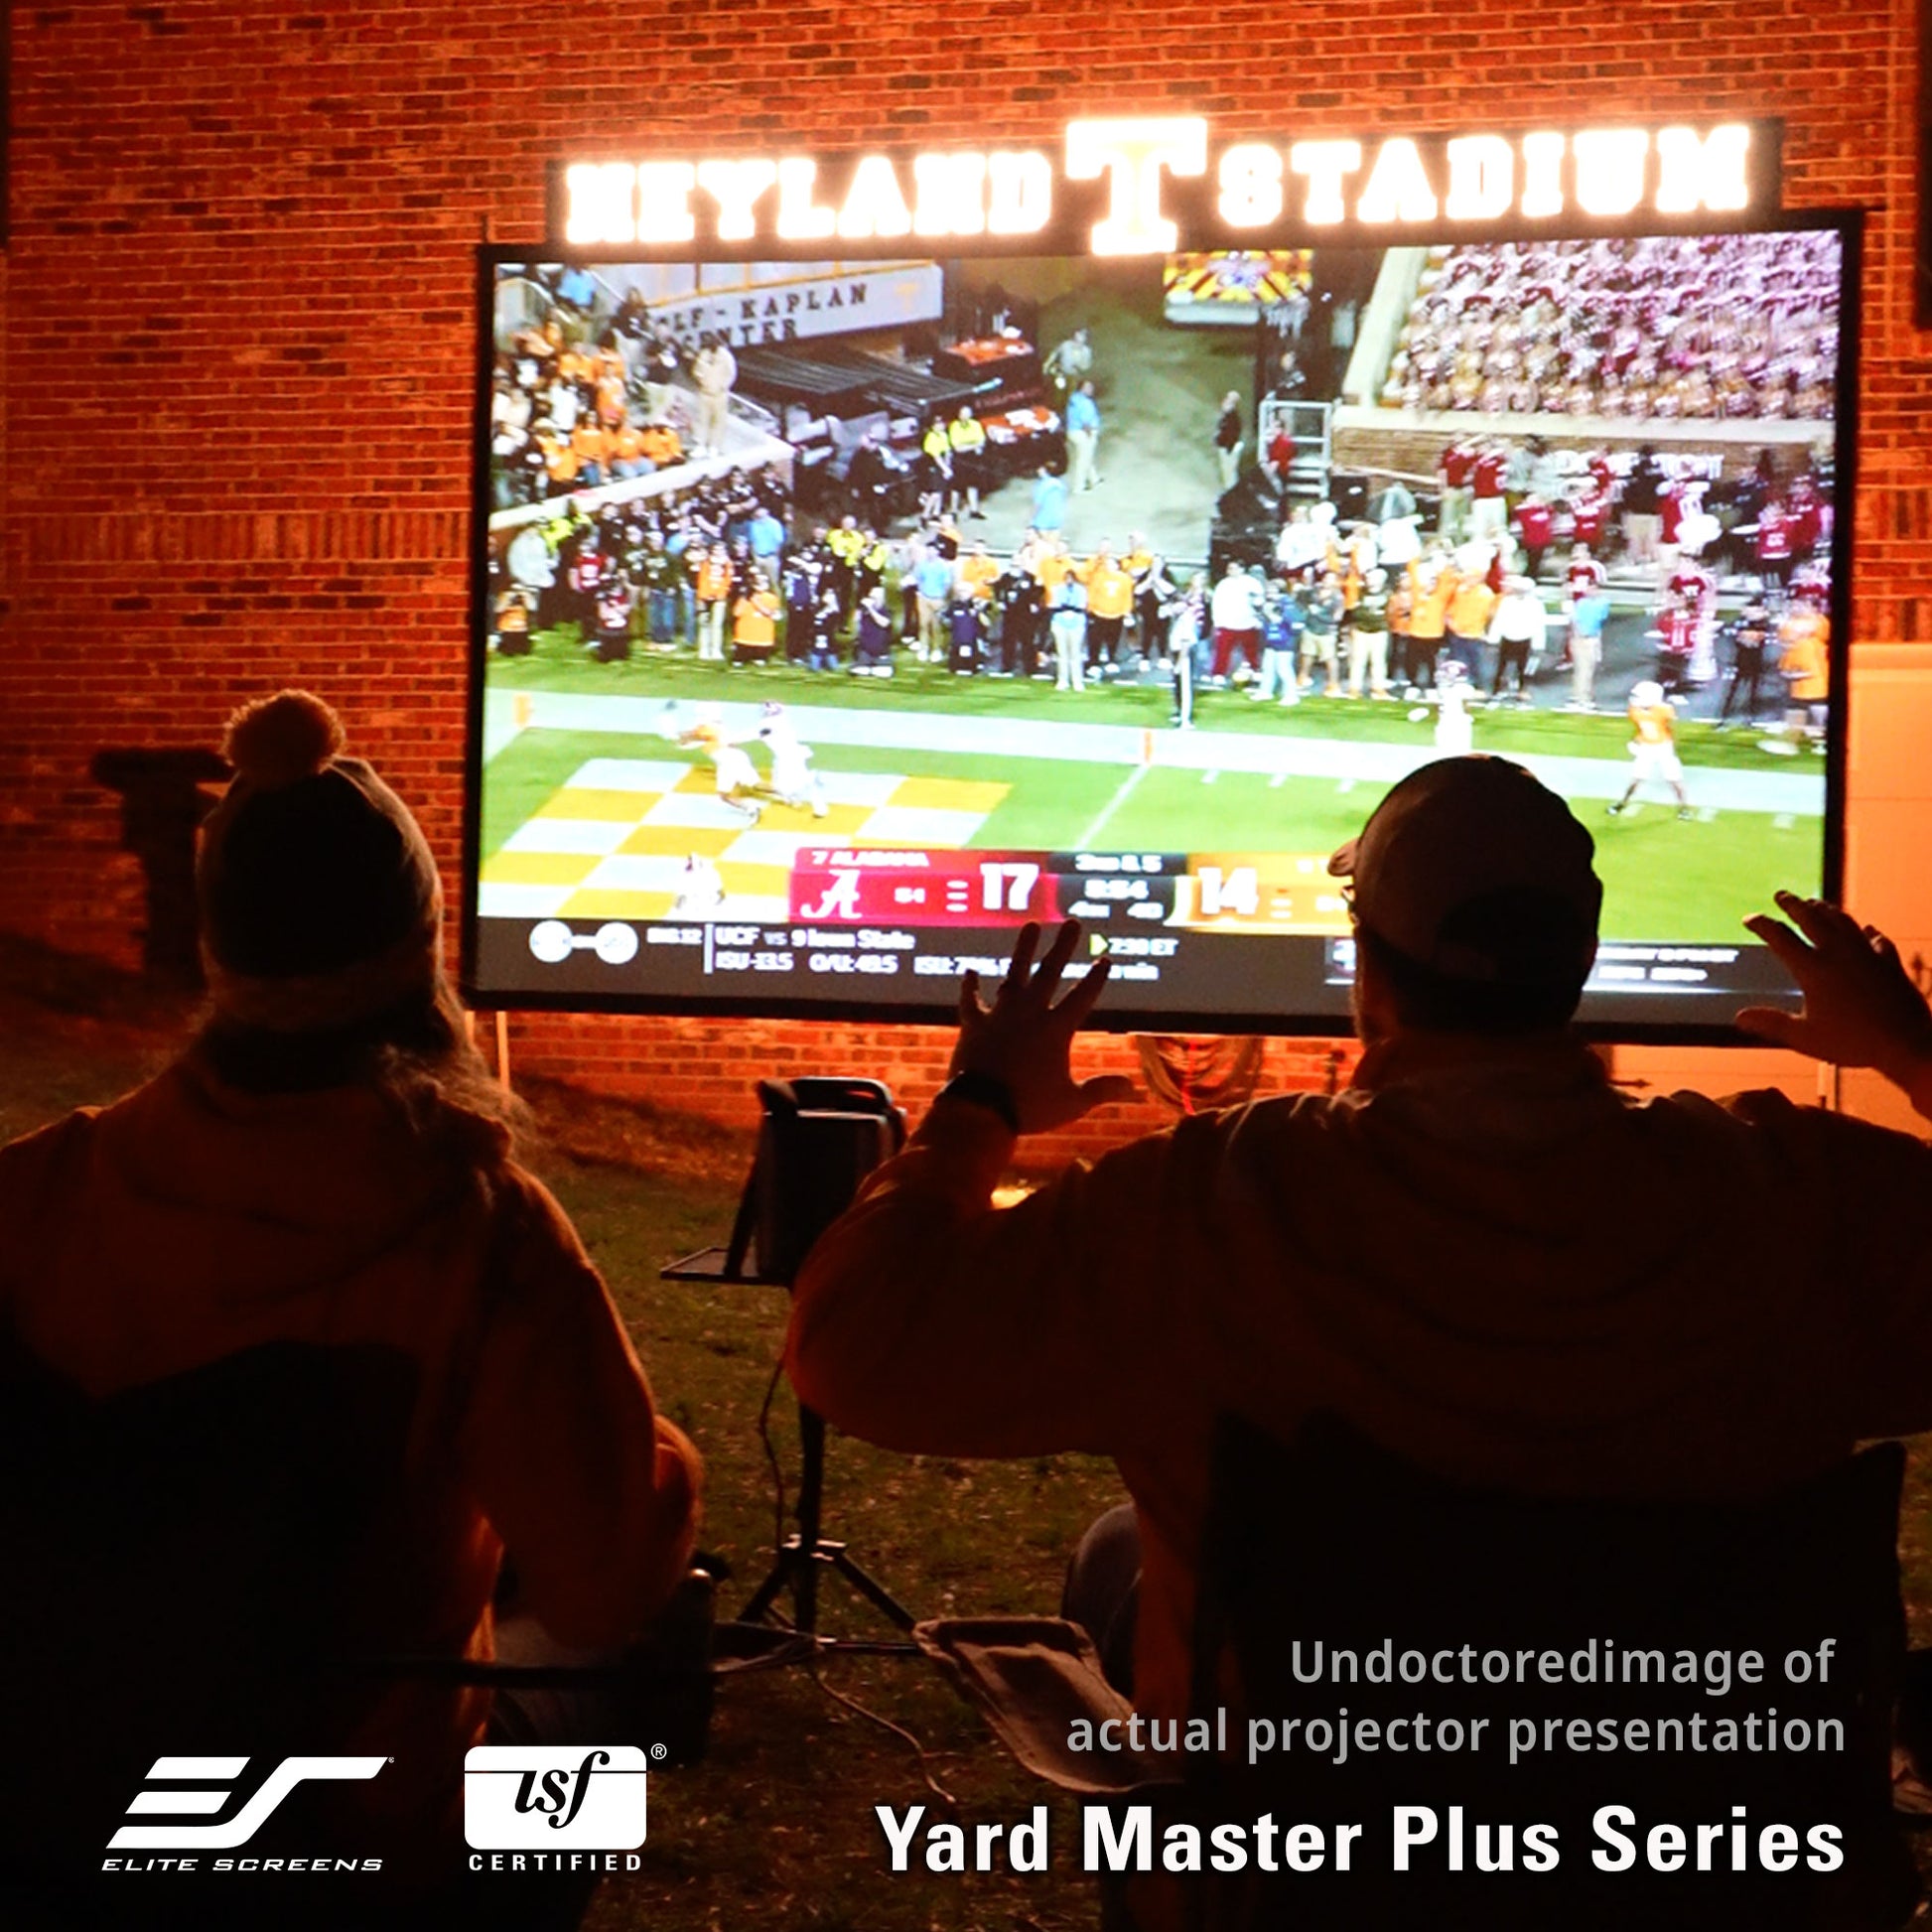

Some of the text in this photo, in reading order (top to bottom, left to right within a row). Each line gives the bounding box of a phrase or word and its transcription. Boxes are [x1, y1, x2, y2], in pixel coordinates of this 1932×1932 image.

[1065, 116, 1208, 256] T
[1218, 125, 1750, 227] STADIUM
[741, 283, 867, 320] KAPLAN
[979, 863, 1039, 910] 17
[1197, 867, 1258, 915] 14
[715, 926, 760, 945] UCF
